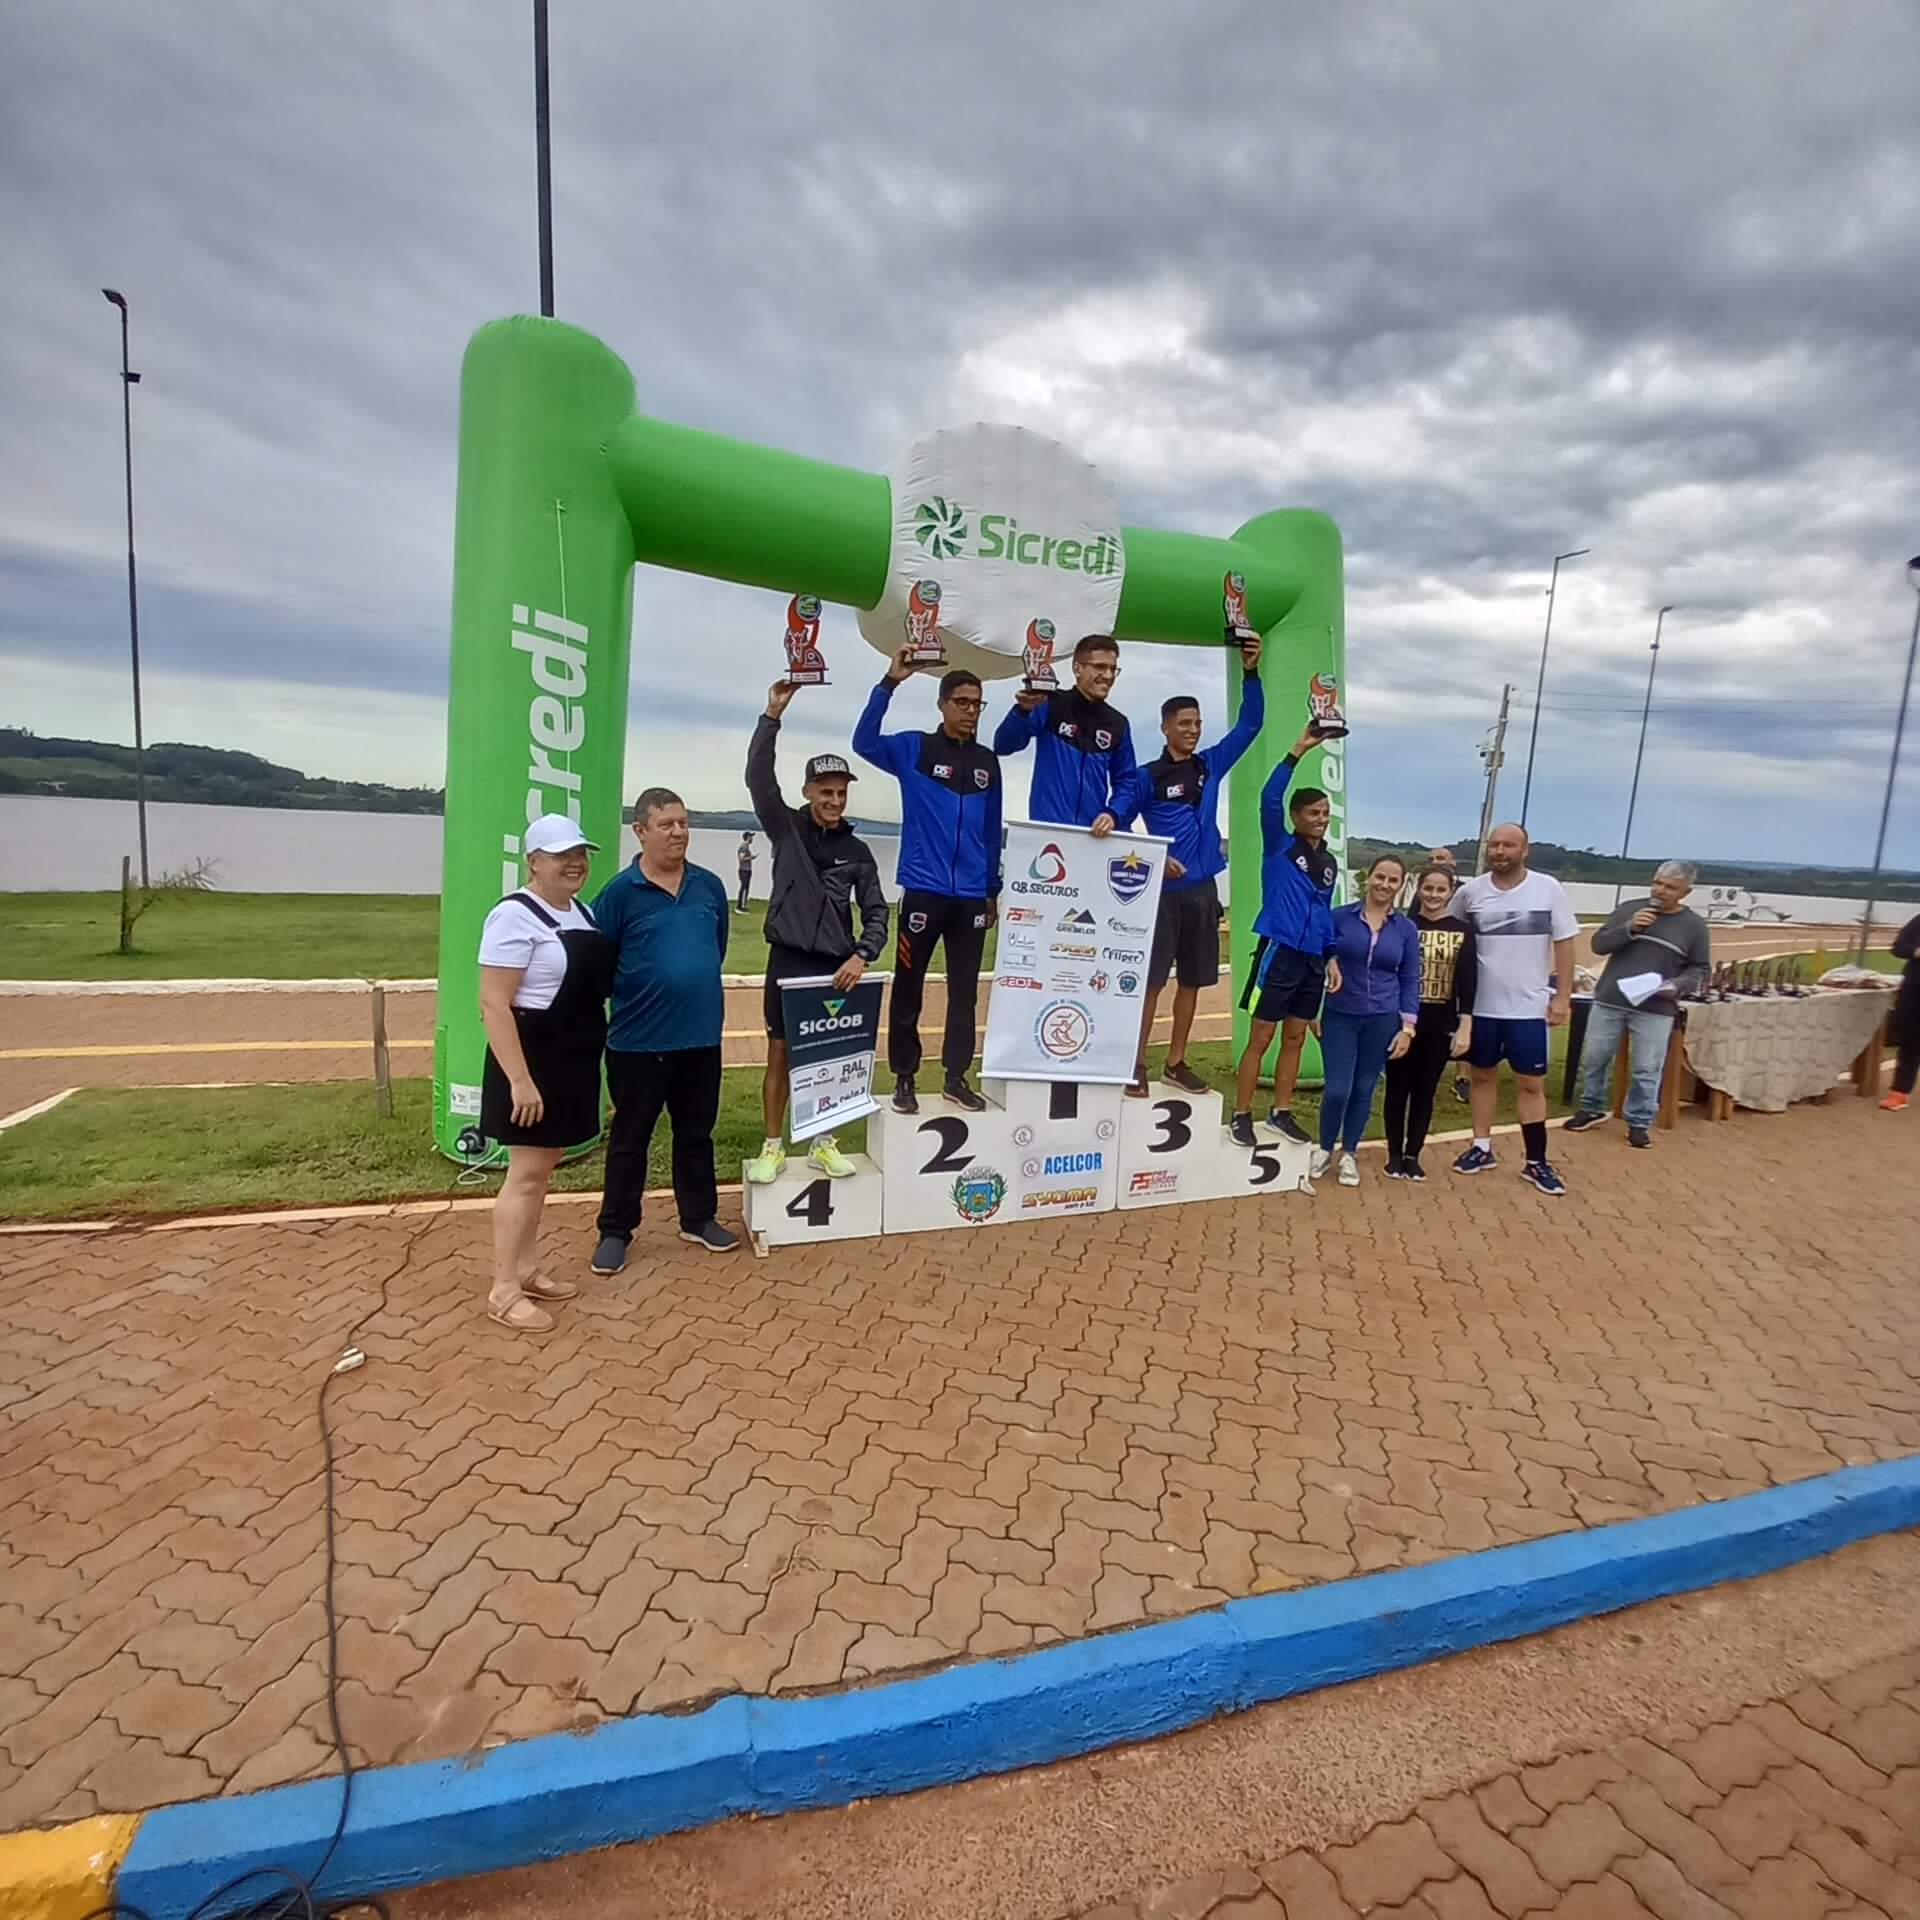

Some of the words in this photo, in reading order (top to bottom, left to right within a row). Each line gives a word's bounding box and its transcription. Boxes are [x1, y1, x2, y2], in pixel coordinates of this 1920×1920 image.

[978, 515, 1115, 575] Sicredi
[1029, 882, 1080, 898] SEGUROS
[799, 1013, 864, 1036] SICOOB
[917, 1116, 977, 1175] 2
[1147, 1099, 1193, 1153] 3
[1044, 1152, 1102, 1175] ACELCOR
[1248, 1143, 1281, 1186] 5
[785, 1178, 835, 1227] 4
